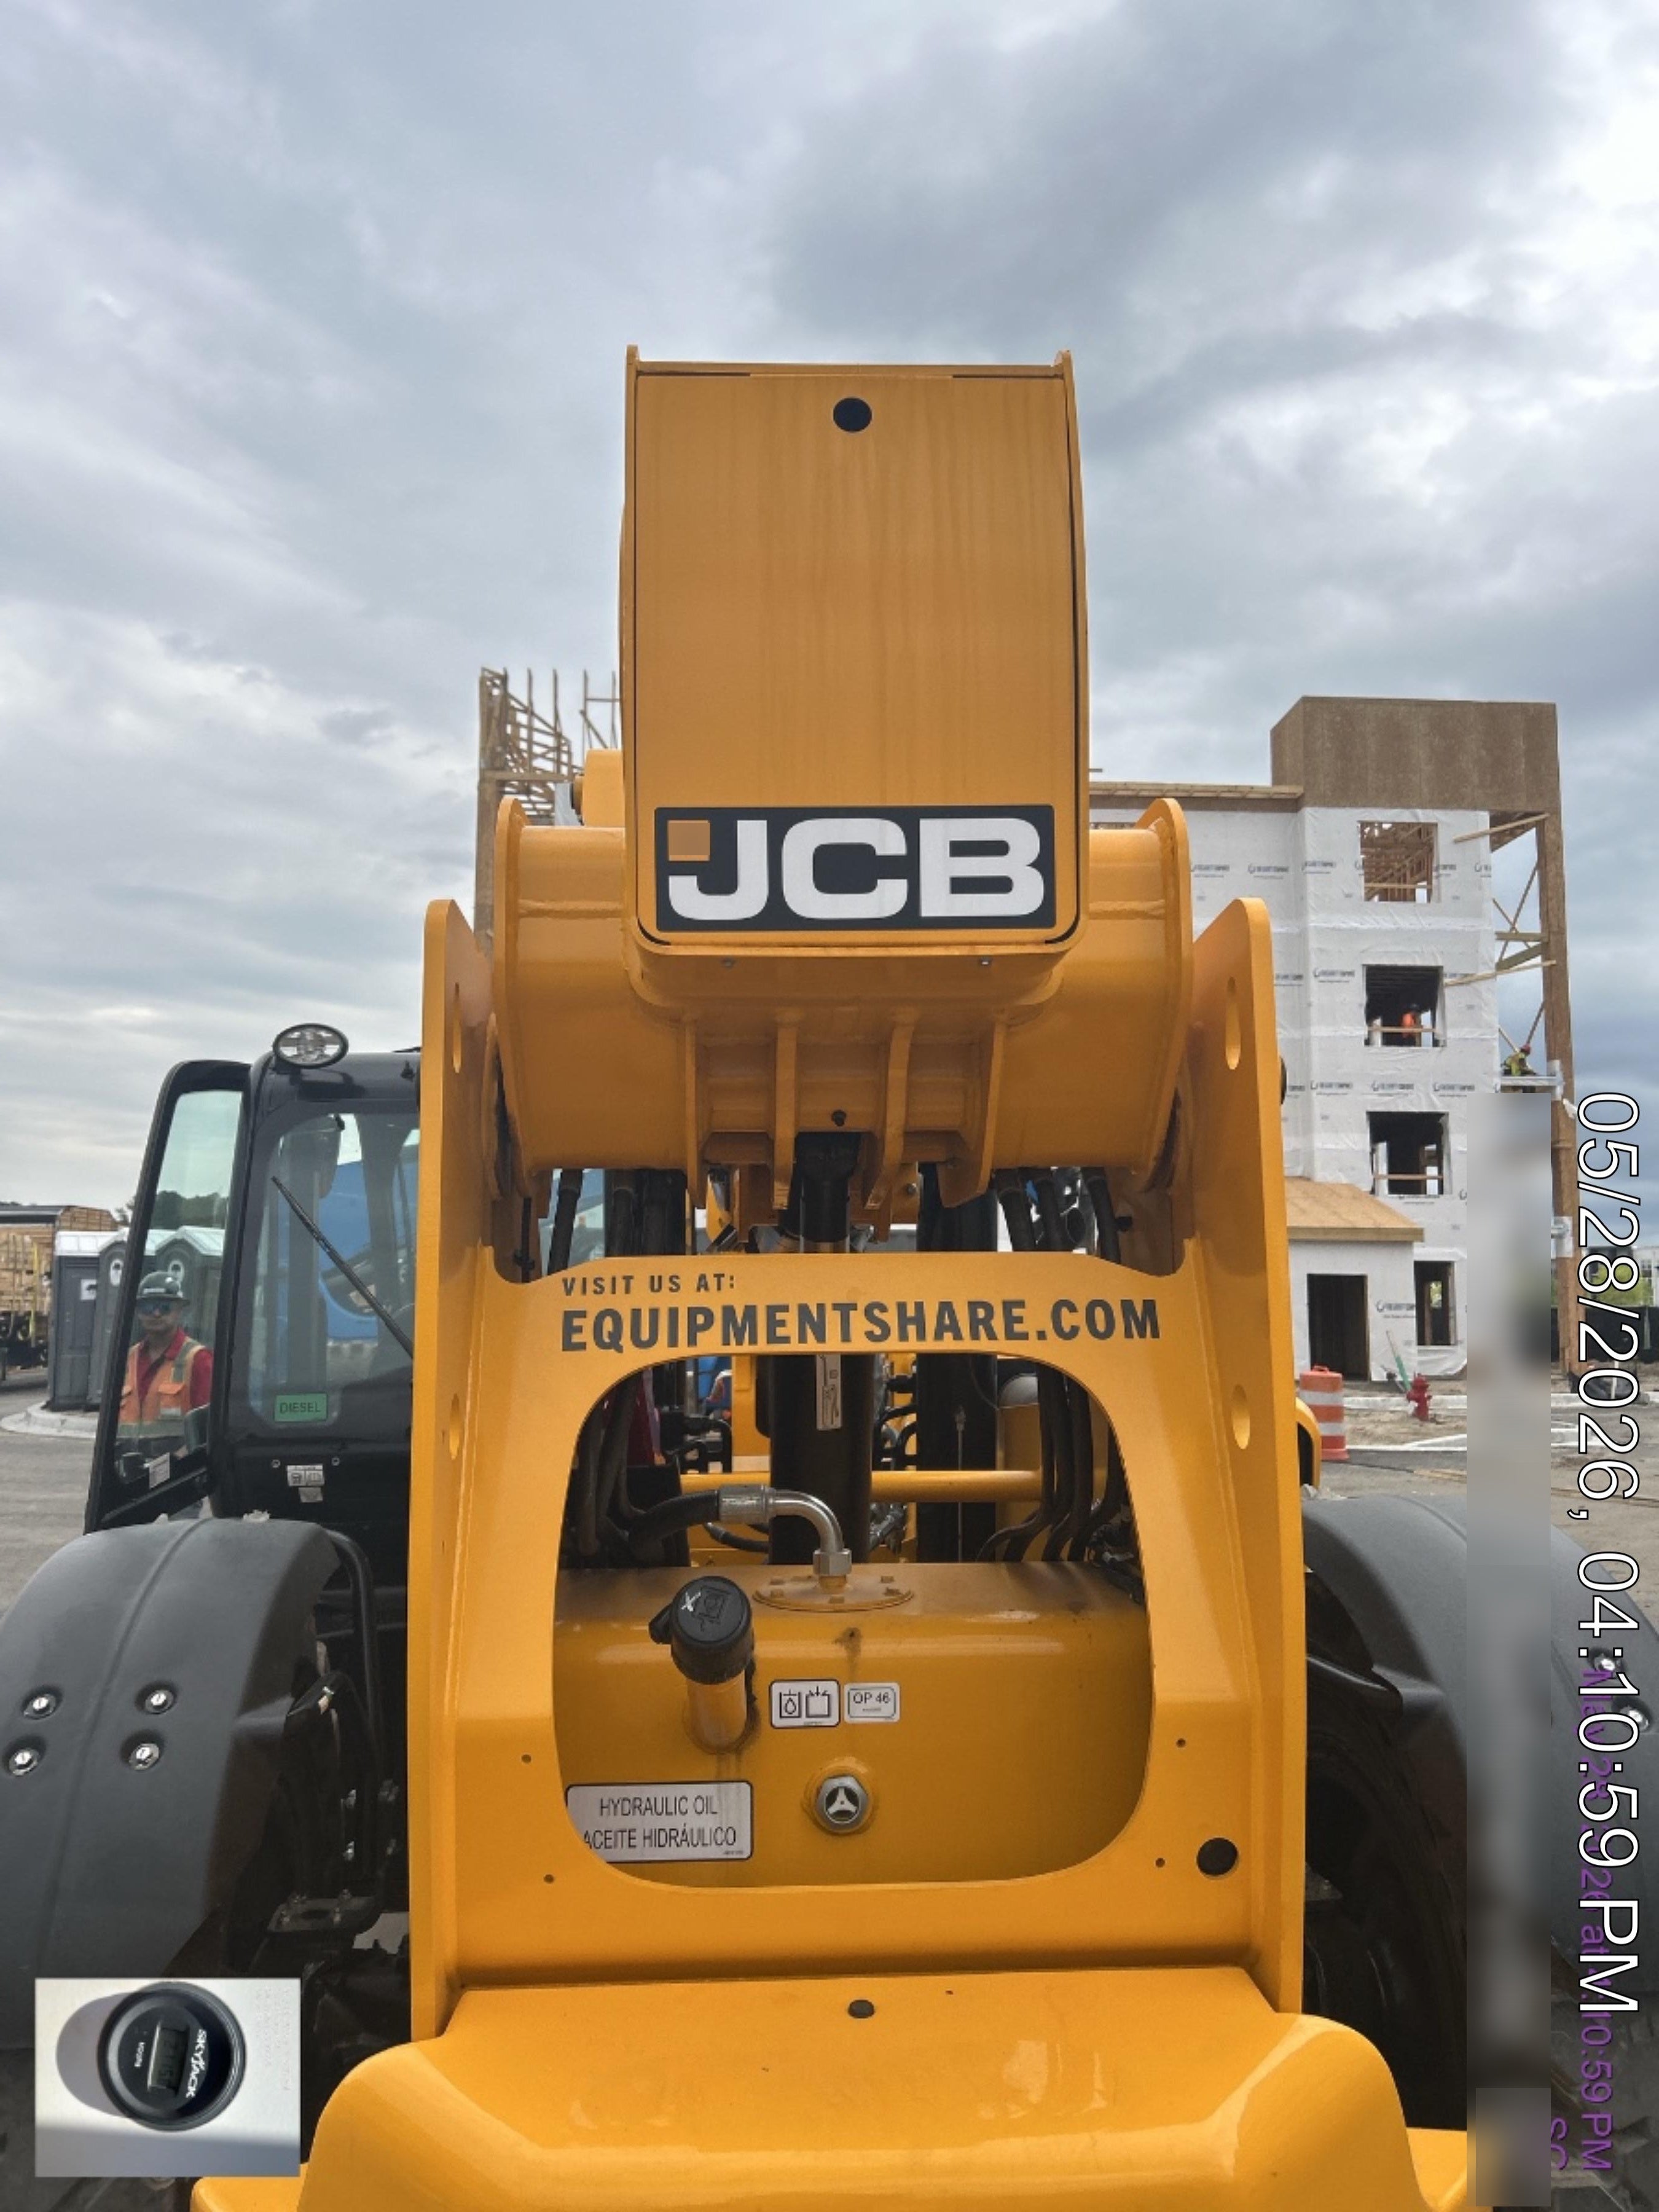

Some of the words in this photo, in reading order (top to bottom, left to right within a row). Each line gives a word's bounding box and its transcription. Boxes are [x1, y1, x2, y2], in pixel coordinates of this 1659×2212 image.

[669, 817, 1045, 920] JCB
[562, 1274, 634, 1296] VISIT
[649, 1274, 681, 1293] US
[696, 1273, 735, 1293] AT:
[562, 1298, 1160, 1354] EQUIPMENTSHARE.COM
[279, 1401, 321, 1414] DIESEL
[853, 1692, 873, 1704] OP
[876, 1692, 890, 1704] 46
[600, 1795, 689, 1817] HYDRAULIC
[693, 1794, 718, 1815] OIL
[584, 1828, 637, 1849] ACEITE
[643, 1823, 737, 1848] HIDRÁULICO
[185, 2028, 208, 2099] SKYJACK
